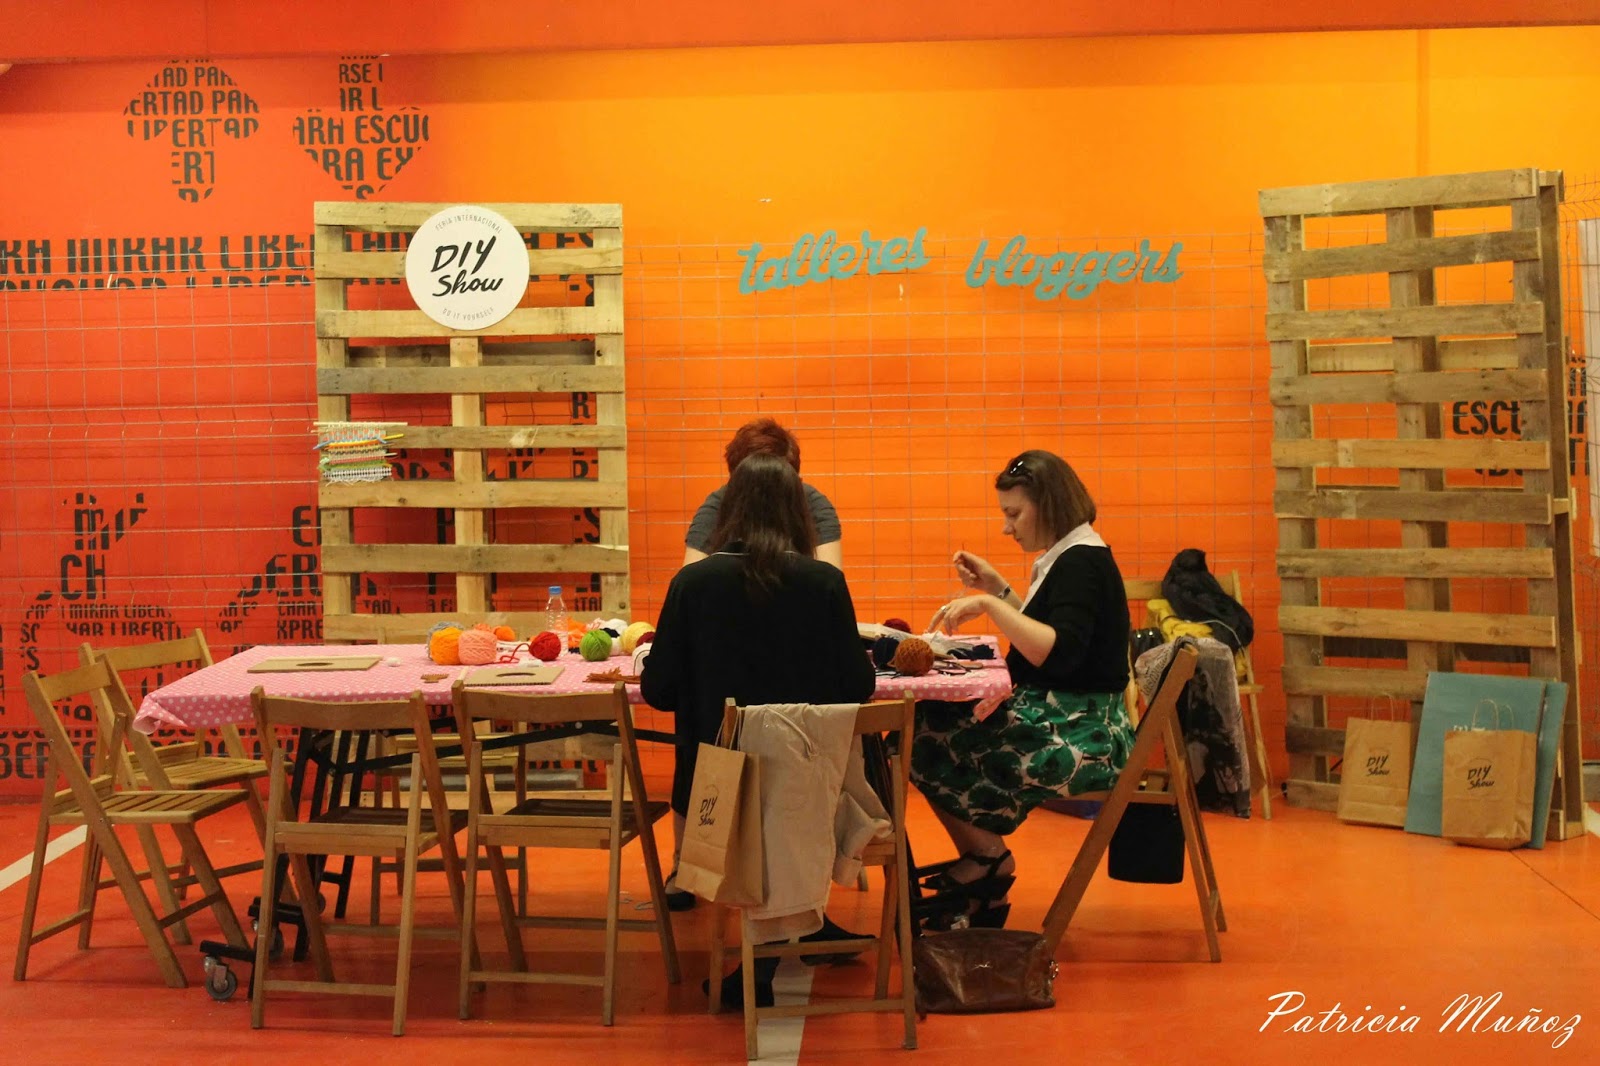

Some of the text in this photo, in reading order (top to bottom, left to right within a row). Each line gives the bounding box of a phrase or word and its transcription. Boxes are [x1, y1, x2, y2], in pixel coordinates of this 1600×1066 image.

[435, 214, 503, 234] FERIA INTERNACIONAL
[430, 235, 497, 275] DIY
[738, 227, 1184, 300] talleres bloggers
[432, 269, 504, 297] Show
[462, 306, 495, 321] YOURSELF
[1366, 754, 1389, 769] DIY
[1365, 766, 1390, 777] Show
[1467, 765, 1492, 780] DIY
[1467, 778, 1495, 790] Show
[699, 796, 718, 816] DIY
[698, 813, 715, 827] Show
